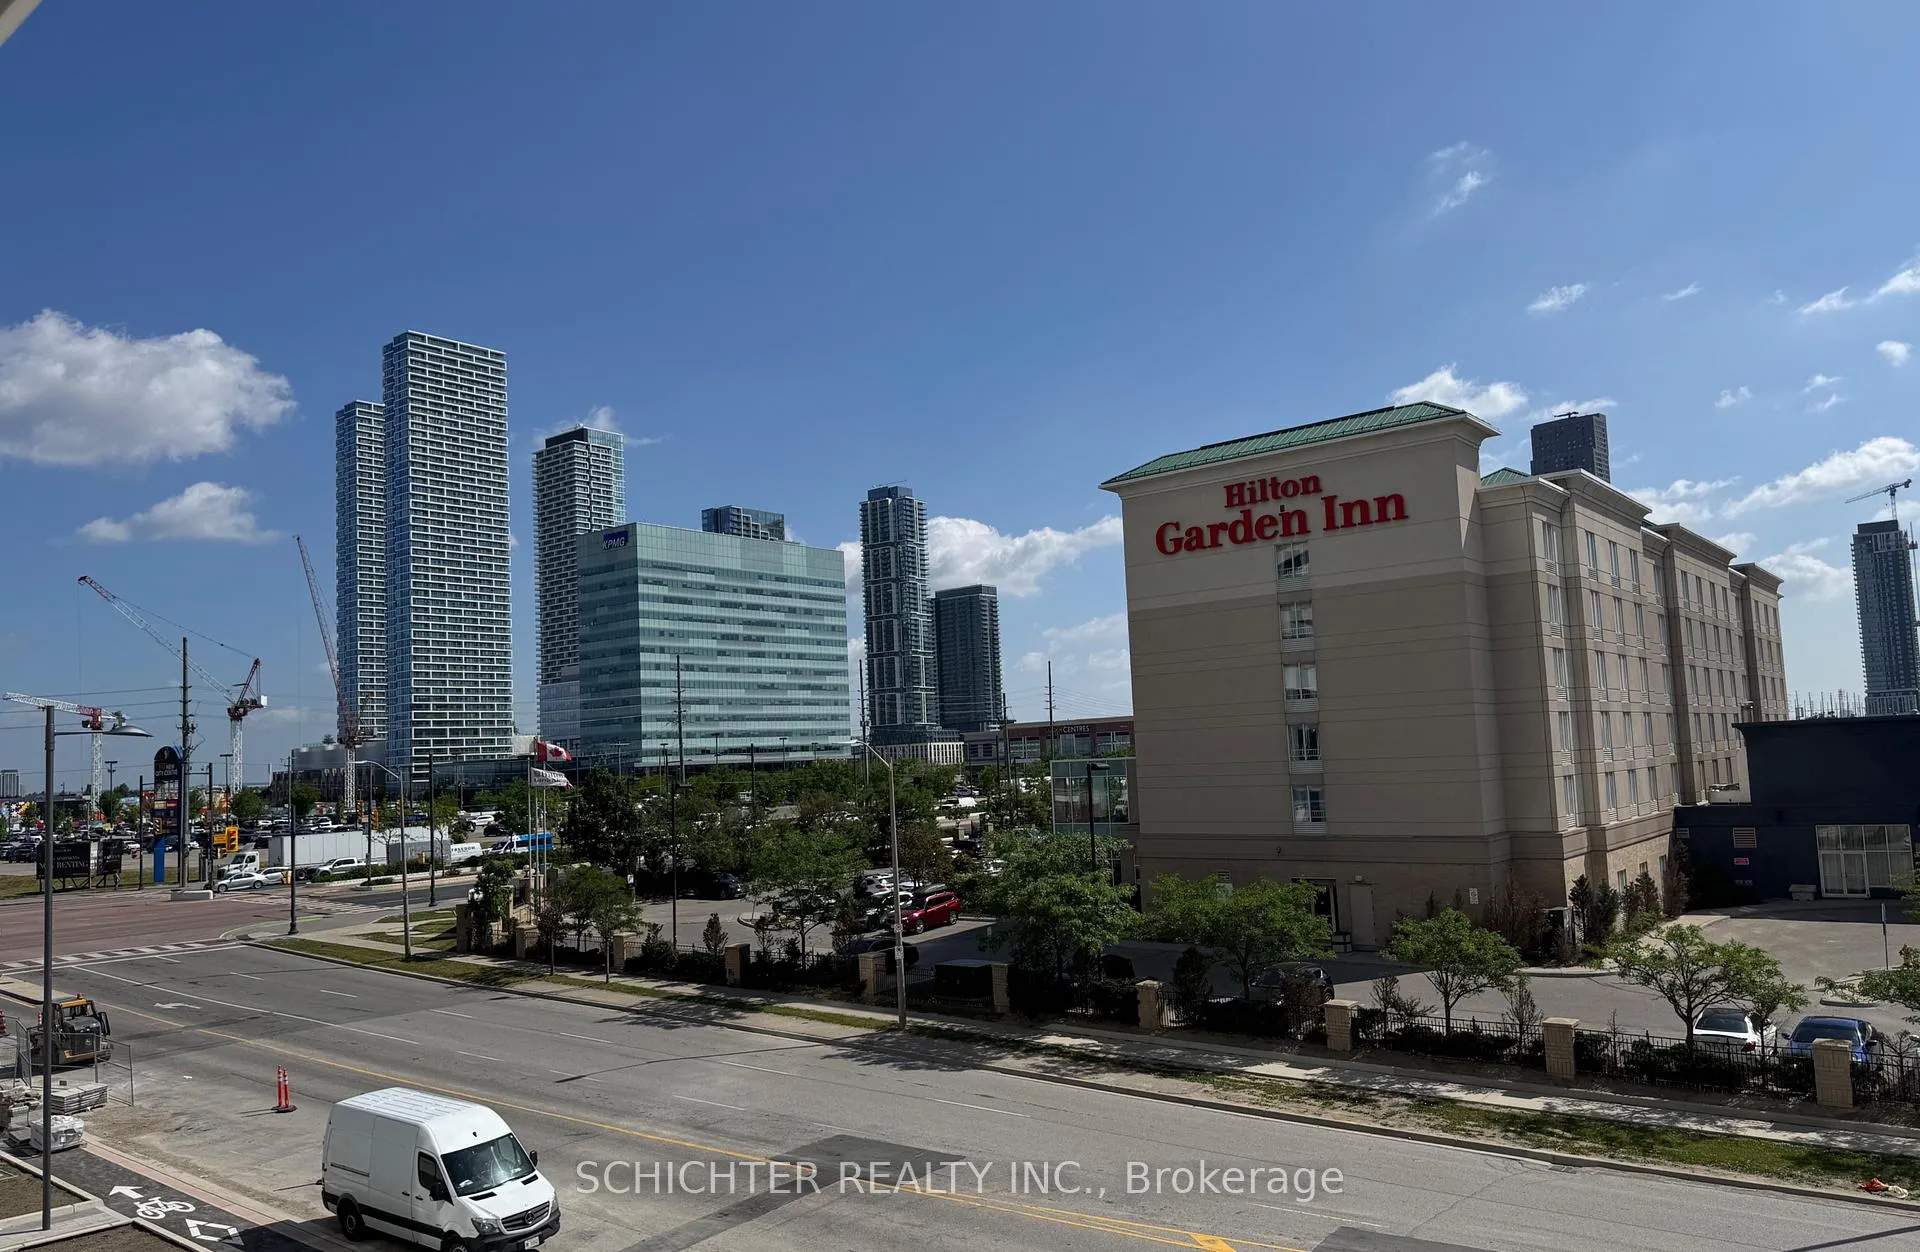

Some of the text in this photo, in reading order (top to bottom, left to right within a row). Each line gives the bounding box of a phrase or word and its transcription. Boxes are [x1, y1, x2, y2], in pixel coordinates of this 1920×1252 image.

[1224, 474, 1322, 508] Hilton
[1155, 491, 1410, 556] Garden Inn
[602, 537, 625, 550] KPMG
